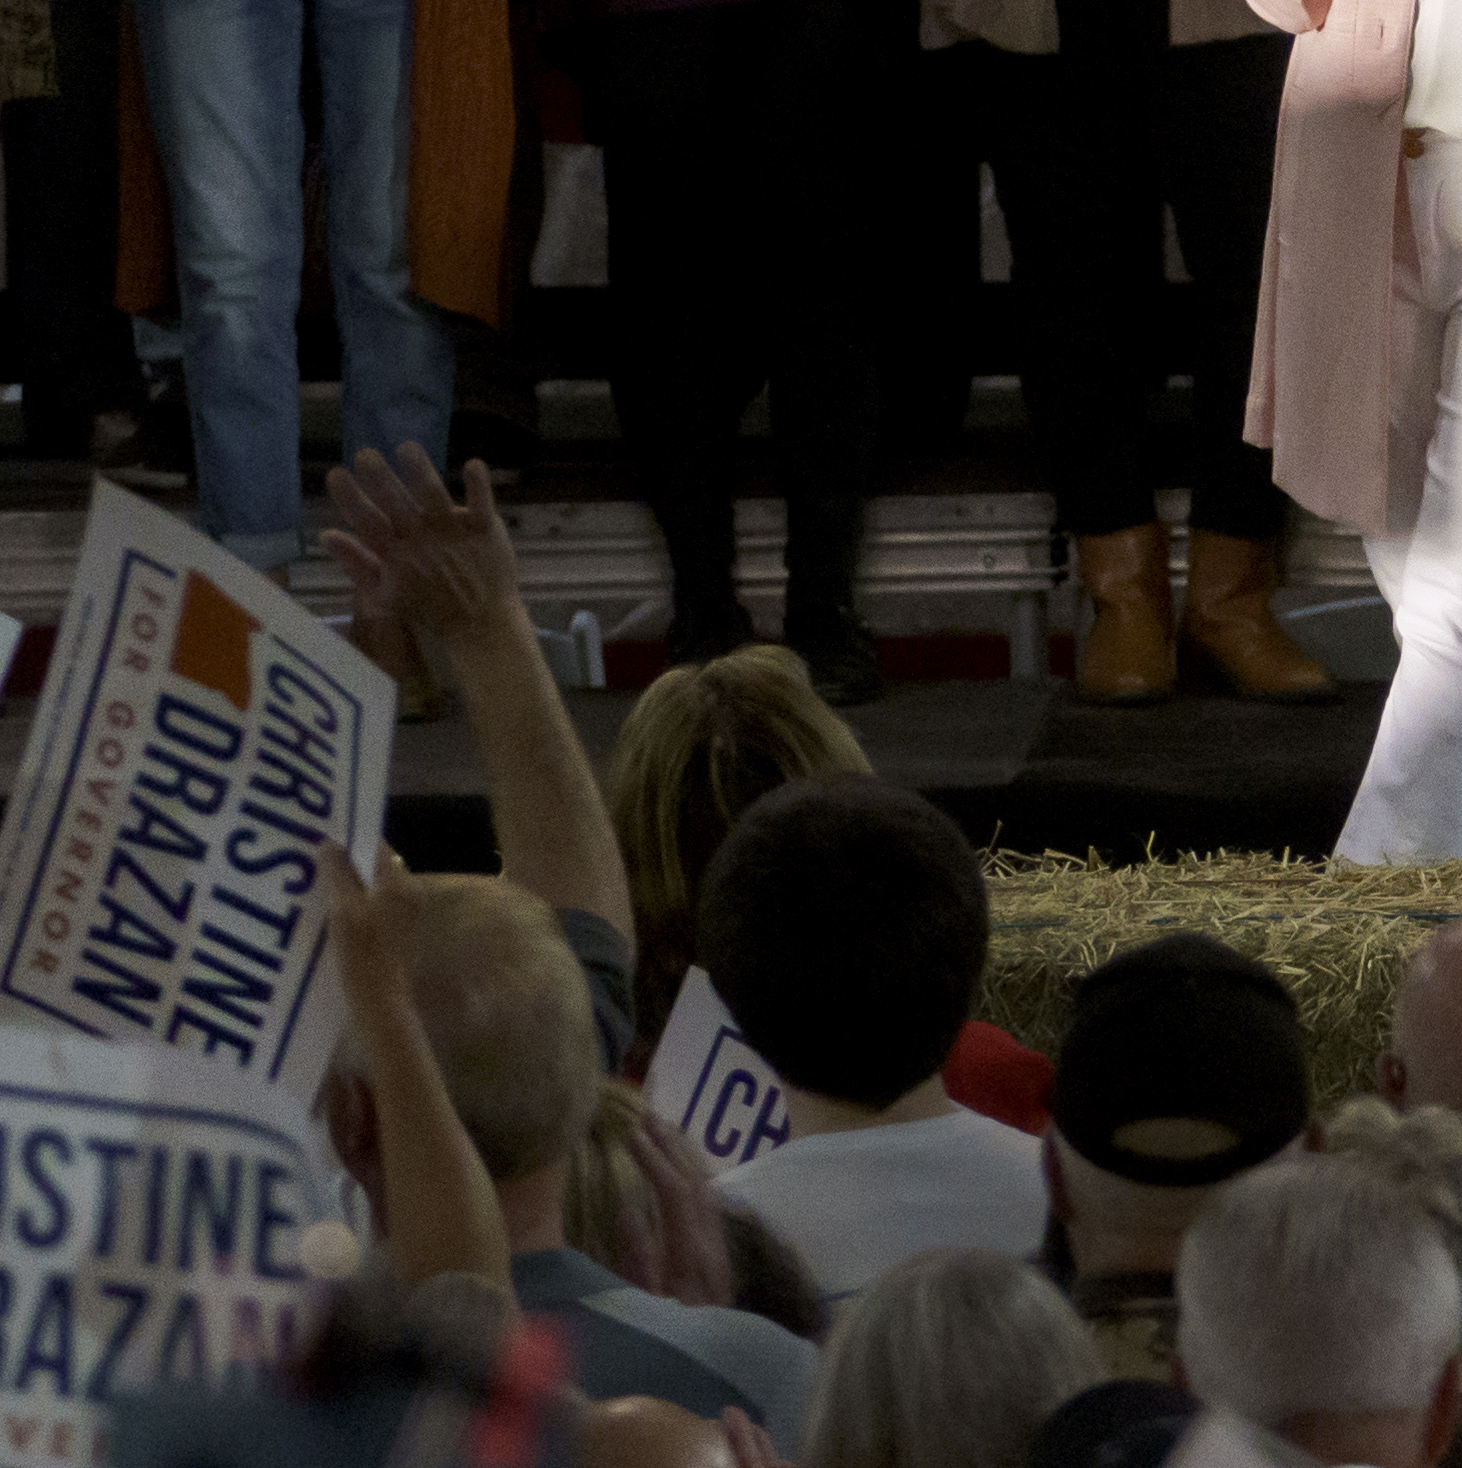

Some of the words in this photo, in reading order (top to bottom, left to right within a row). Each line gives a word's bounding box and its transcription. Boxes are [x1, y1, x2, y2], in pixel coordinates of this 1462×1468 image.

[123, 585, 165, 675] FOR
[30, 698, 136, 975] GOVERNOR
[71, 693, 243, 1030] DRAZAN
[165, 663, 340, 1069] CHRISTINE
